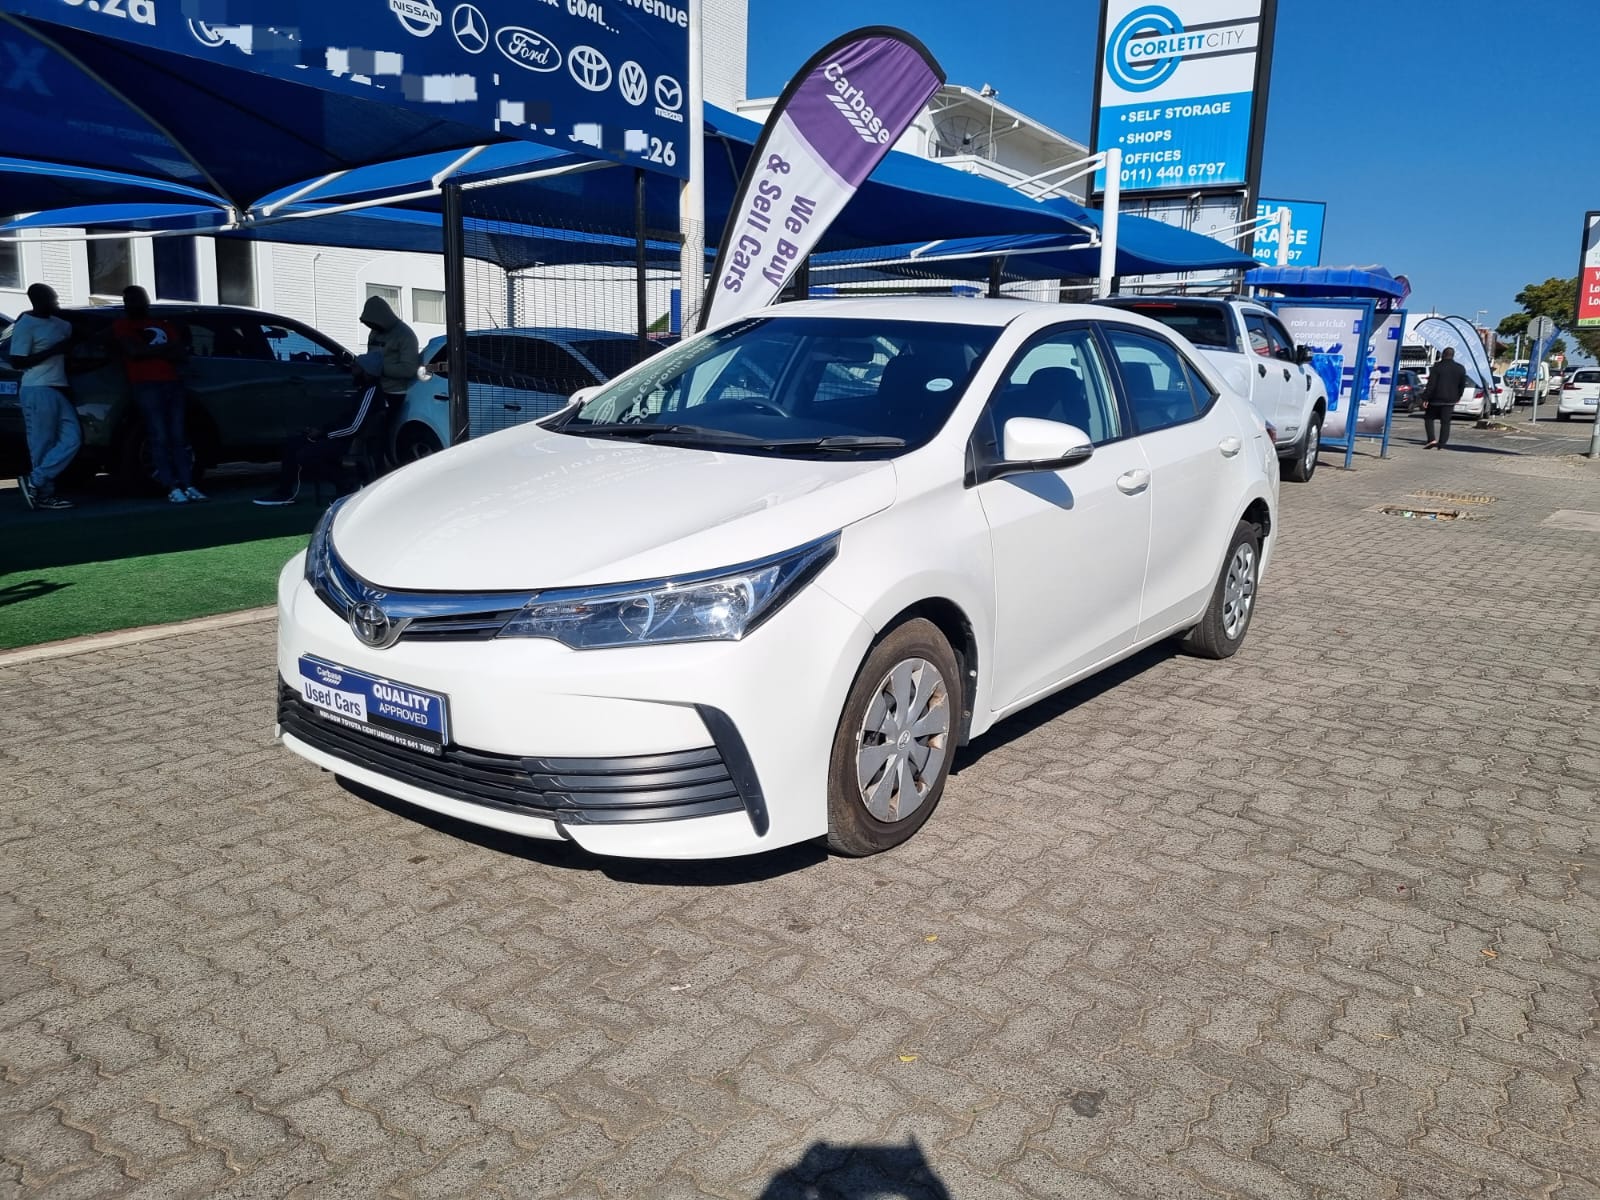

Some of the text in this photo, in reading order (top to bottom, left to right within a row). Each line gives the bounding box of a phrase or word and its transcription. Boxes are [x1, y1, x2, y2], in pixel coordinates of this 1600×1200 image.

[393, 0, 439, 22] NISSAN
[508, 32, 551, 65] Ford
[1130, 29, 1245, 57] CORLETT CITY
[655, 107, 684, 123] mazda
[823, 63, 890, 144] Carbase
[1128, 102, 1231, 122] SELF STORAGE
[1126, 130, 1171, 144] SHOPS
[1124, 150, 1181, 165] OFFICES
[1121, 162, 1226, 183] 011) 440 6797
[724, 154, 790, 293] & Sell Cars
[763, 195, 816, 288] We Buy
[1254, 228, 1308, 245] RAGE
[305, 682, 362, 717] Used Cars
[373, 684, 430, 711] QUALITY
[379, 702, 428, 725] APPROVED
